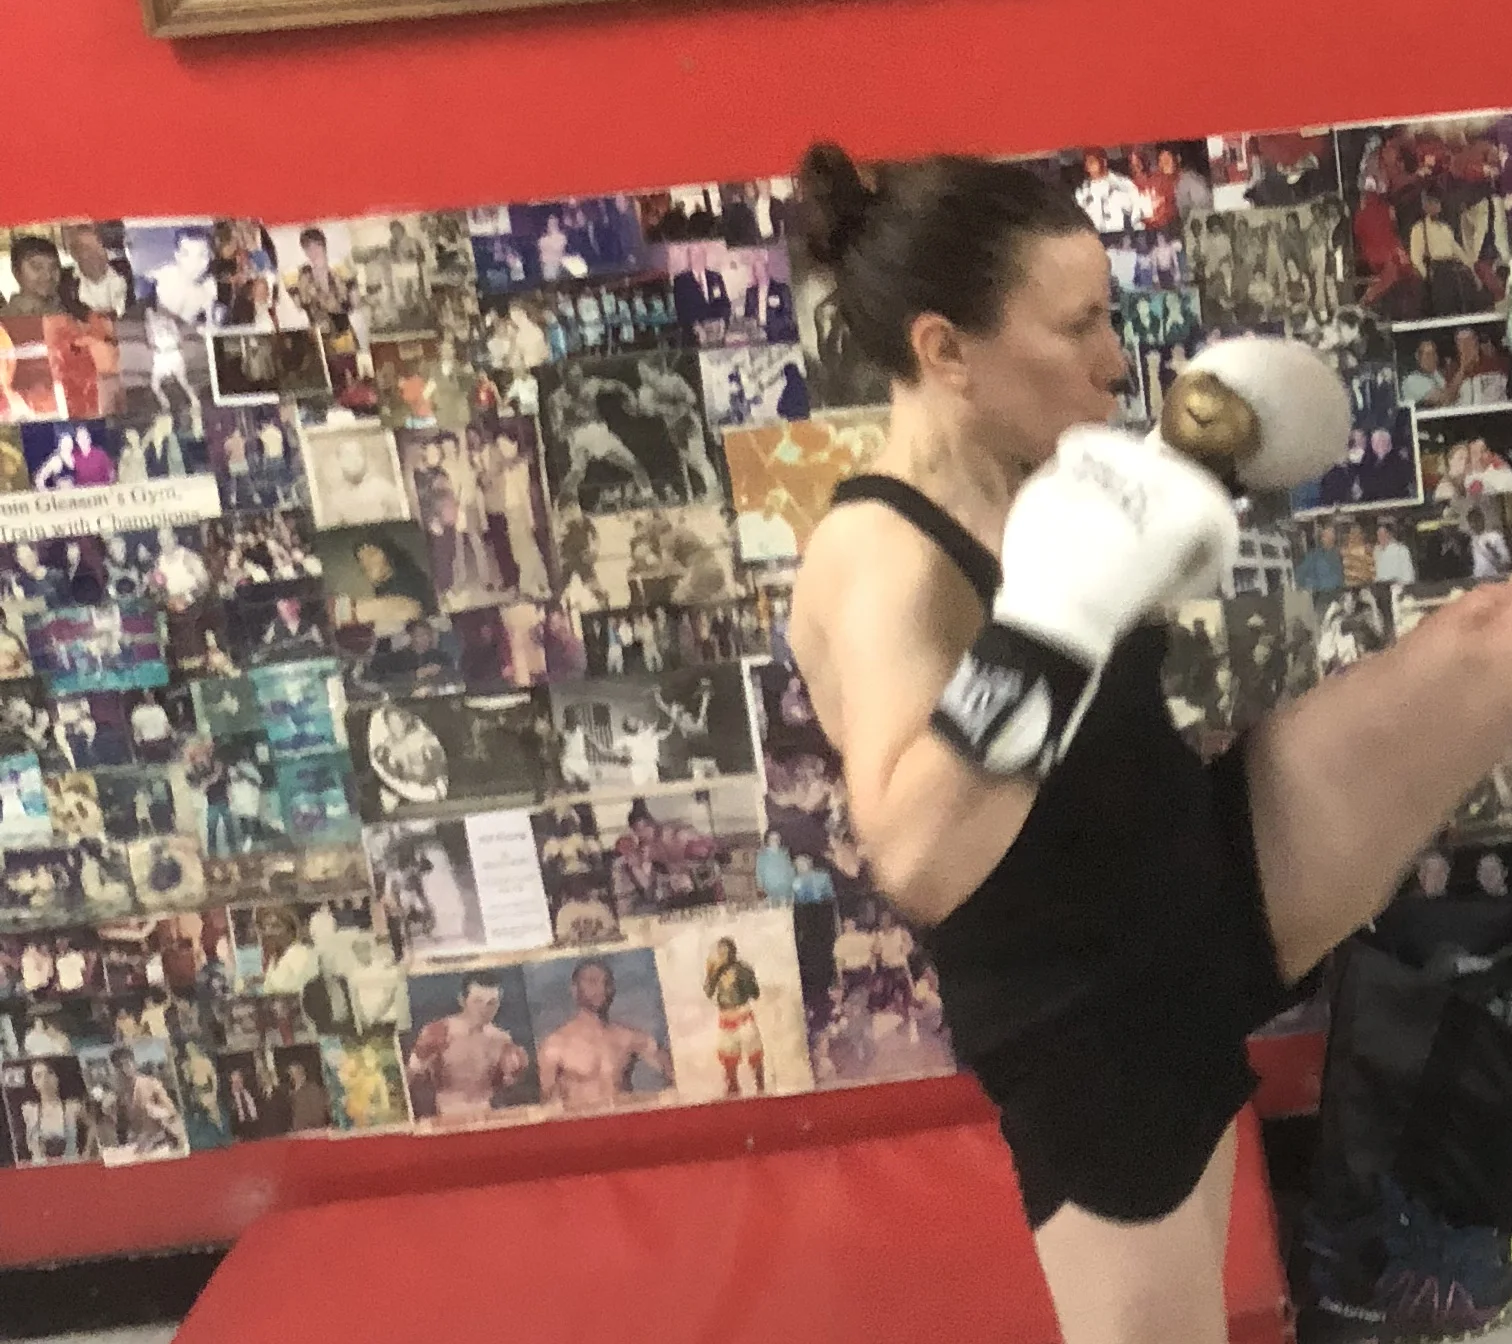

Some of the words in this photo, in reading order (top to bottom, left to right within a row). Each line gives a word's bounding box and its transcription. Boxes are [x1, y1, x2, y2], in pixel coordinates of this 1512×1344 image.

[34, 487, 125, 512] Gleason's
[52, 517, 90, 537] with
[96, 508, 200, 534] Champions
